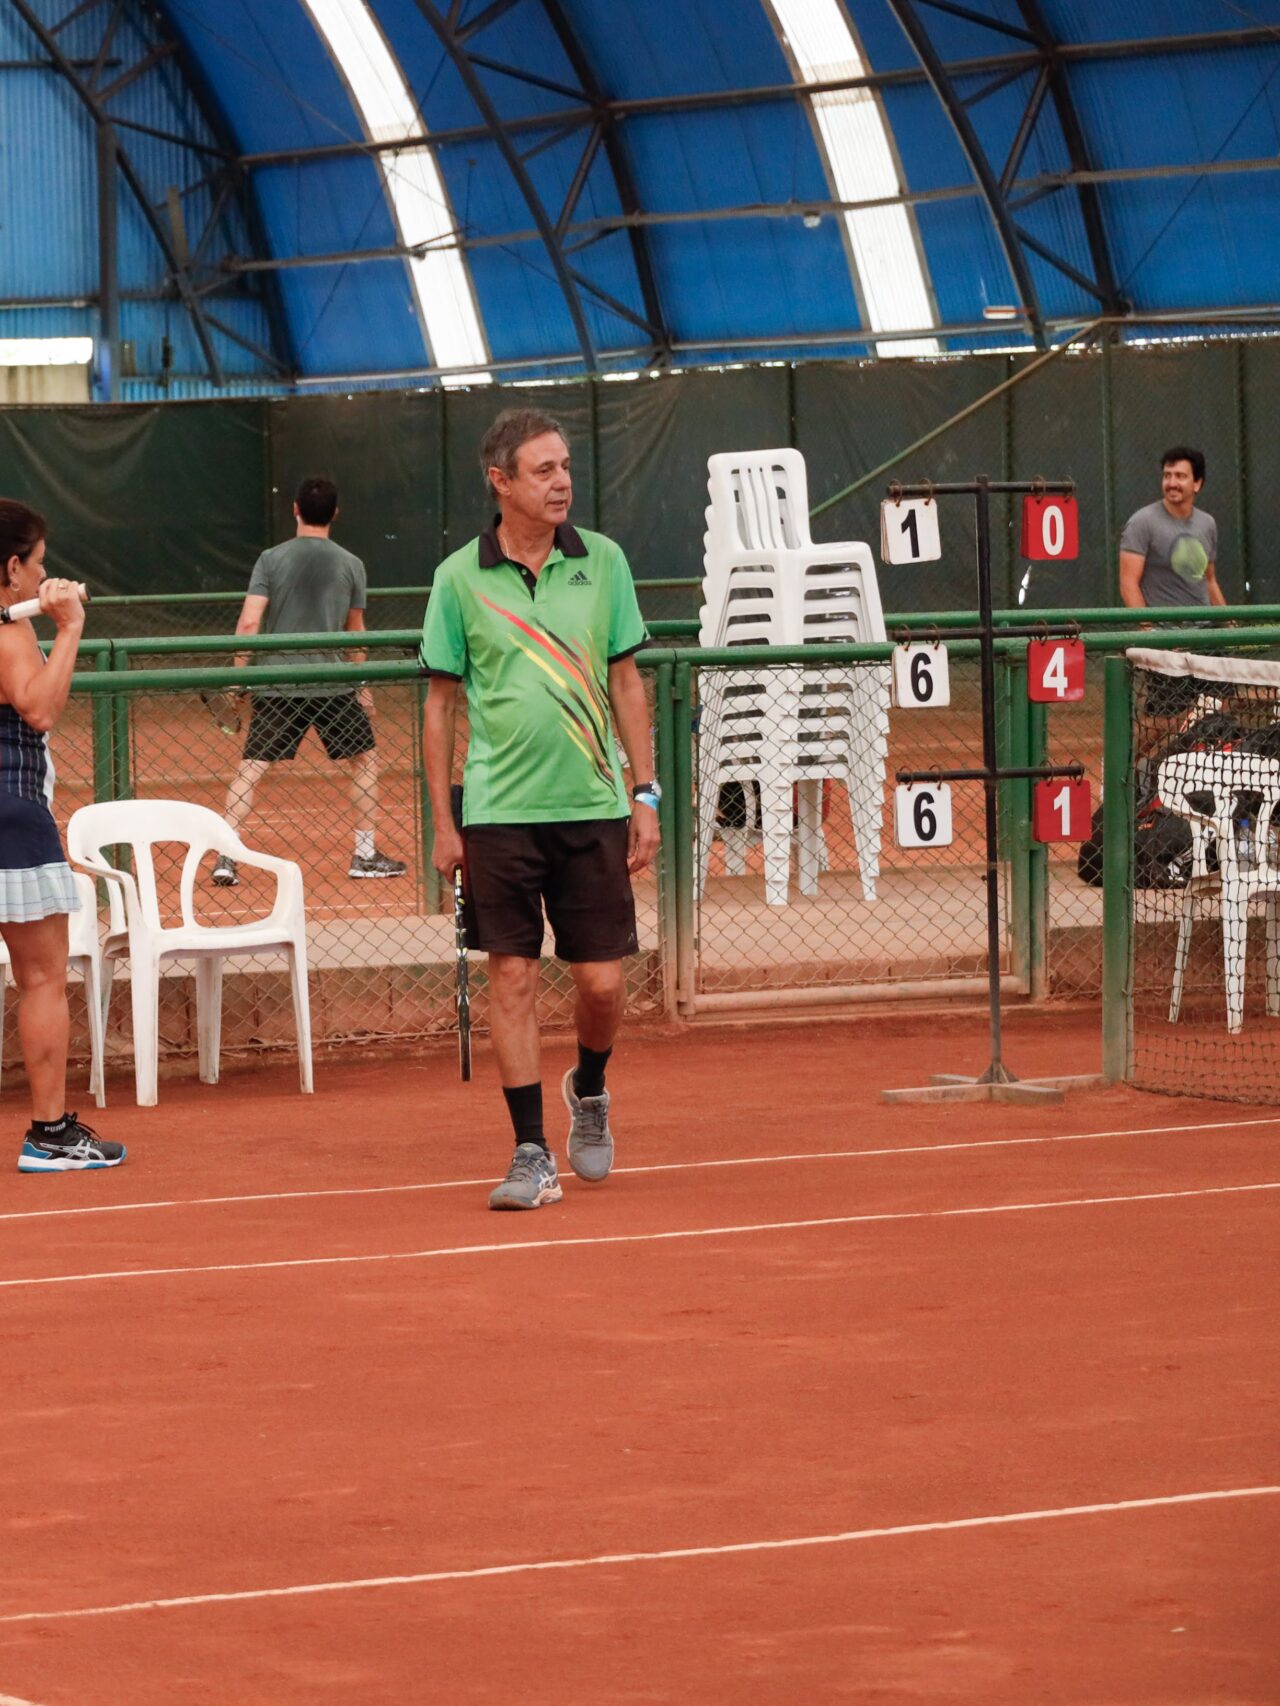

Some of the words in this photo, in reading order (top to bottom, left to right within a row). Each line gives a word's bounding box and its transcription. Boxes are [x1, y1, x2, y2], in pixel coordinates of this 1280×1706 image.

[900, 509, 921, 559] 1
[1042, 505, 1064, 556] 0
[910, 651, 933, 702] 6
[1042, 647, 1068, 698] 4
[913, 791, 937, 842] 6
[1052, 786, 1071, 837] 1
